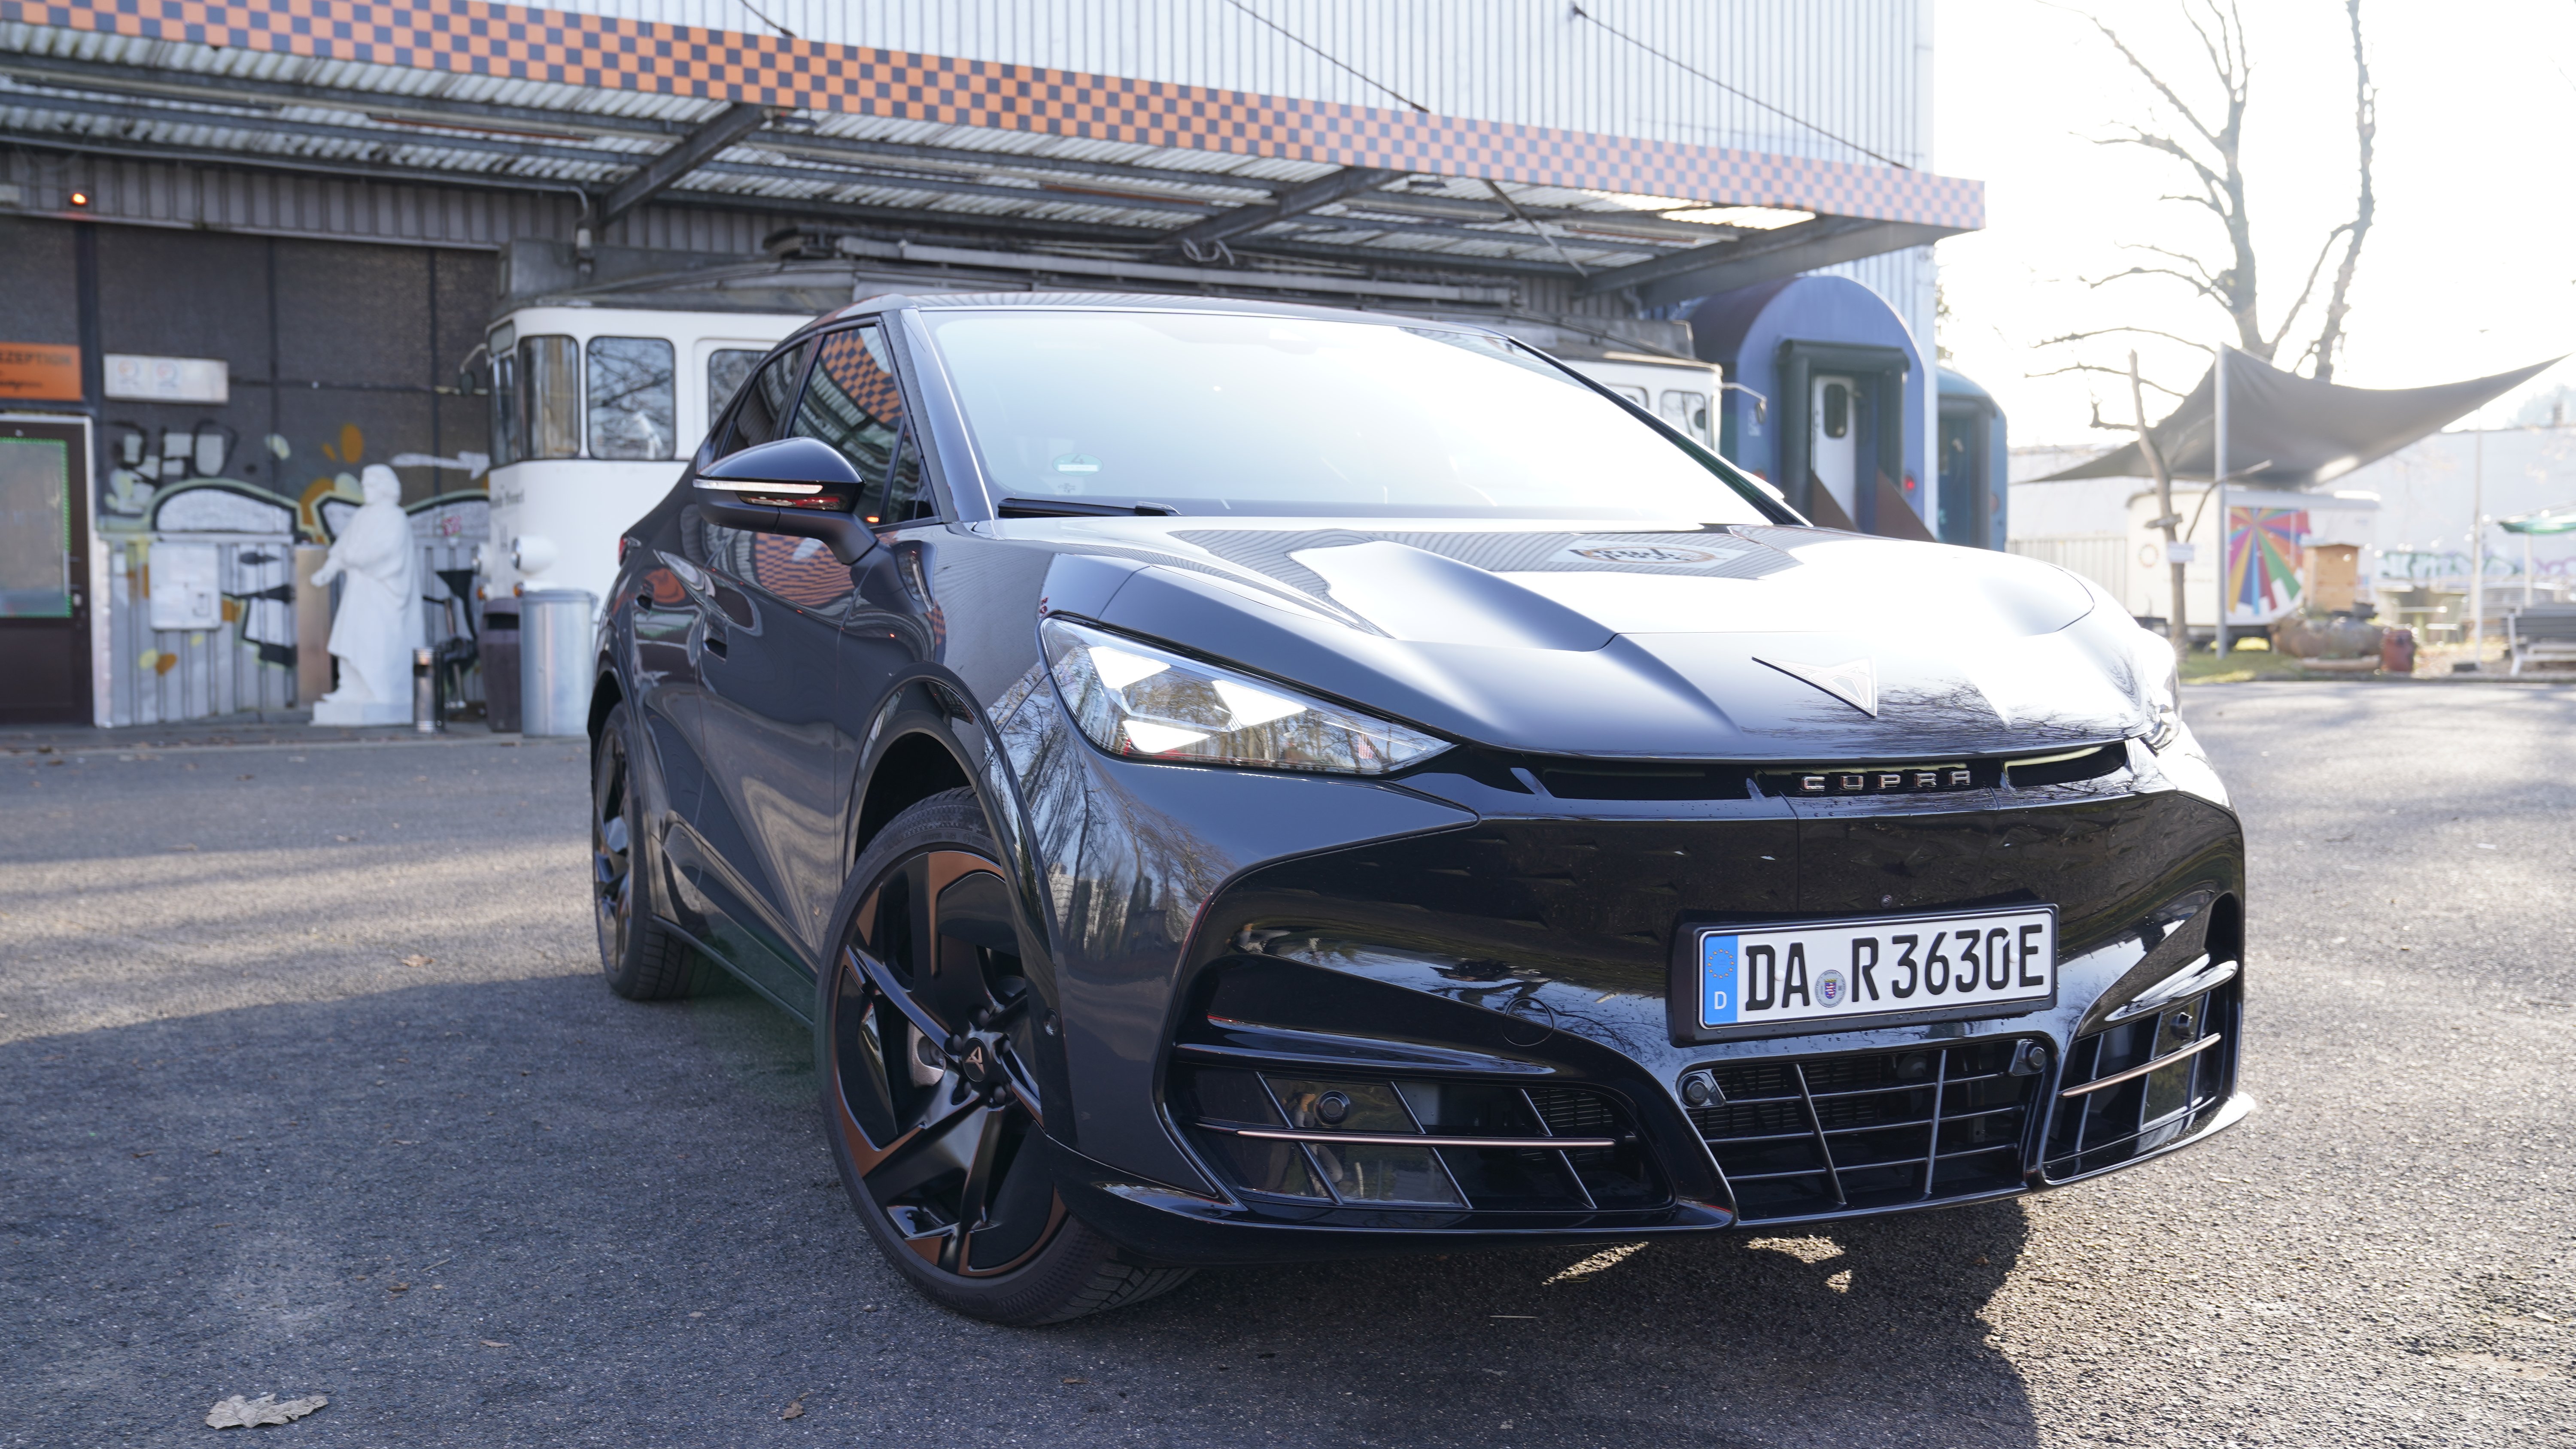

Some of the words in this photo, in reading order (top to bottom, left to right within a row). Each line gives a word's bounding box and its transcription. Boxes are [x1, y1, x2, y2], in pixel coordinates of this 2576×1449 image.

[1801, 770, 1970, 791] CUPRA
[1745, 942, 1810, 1011] DA
[1714, 991, 1727, 1010] D
